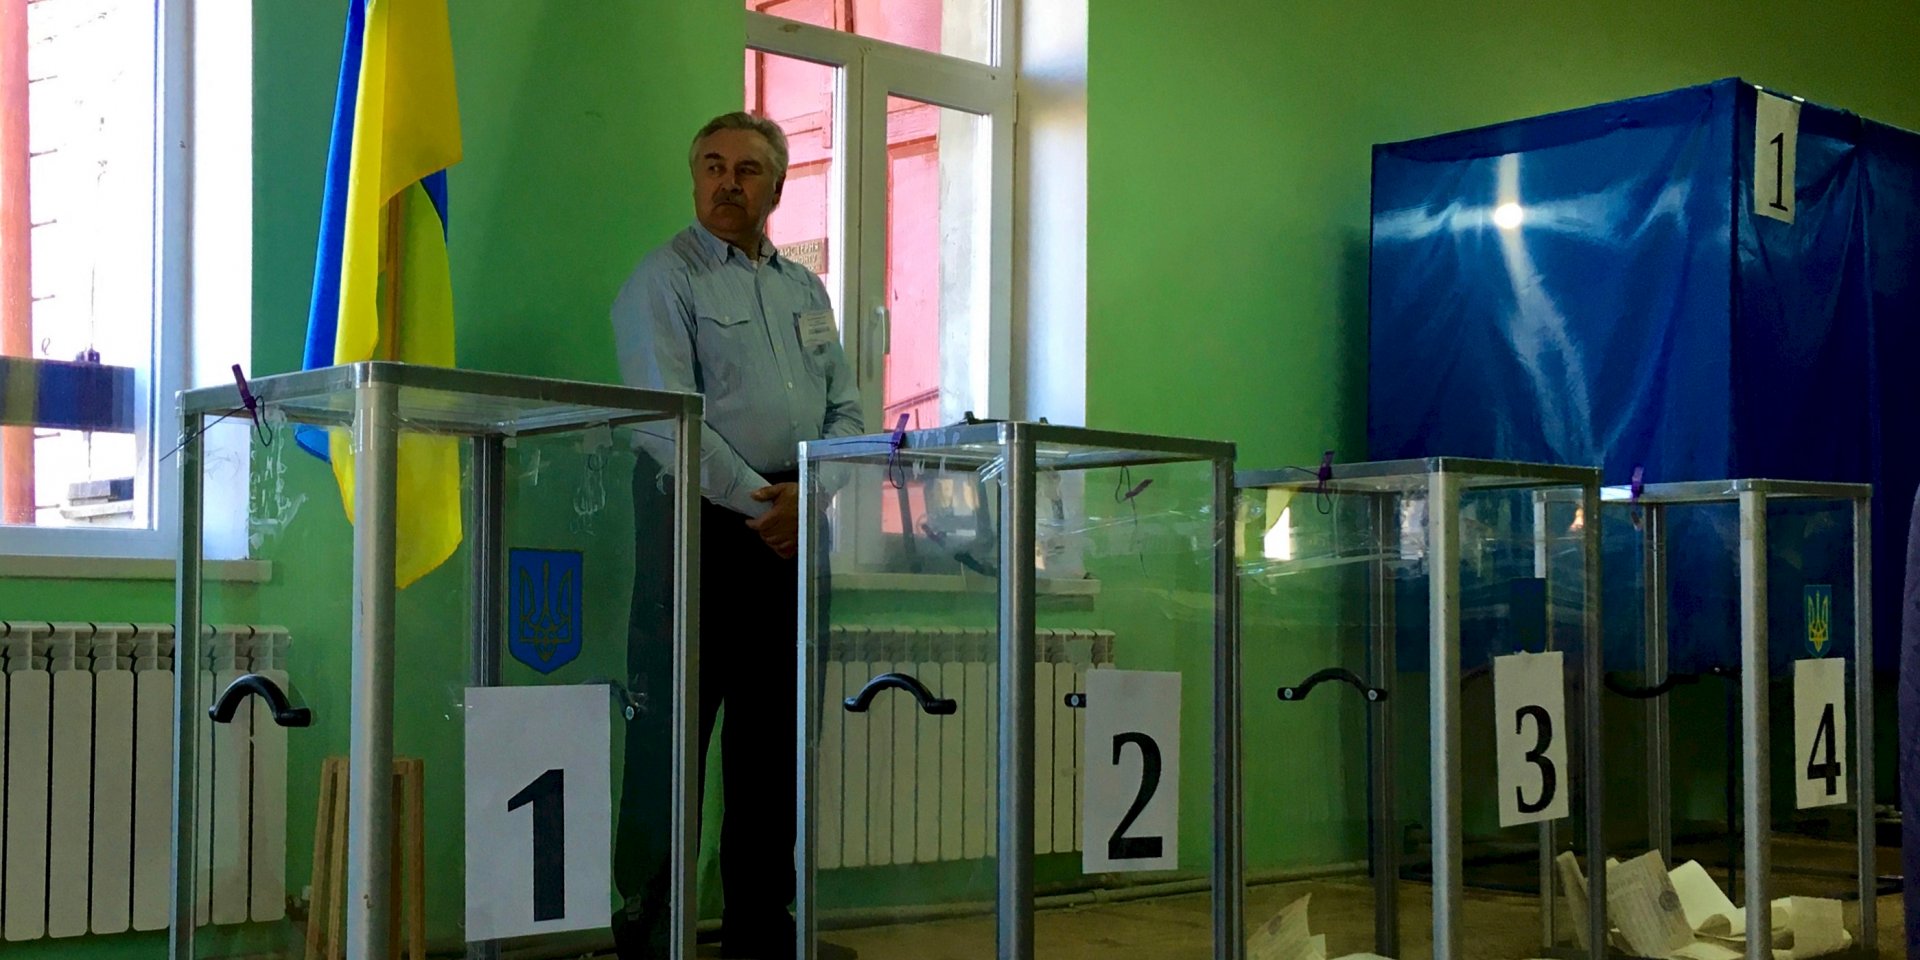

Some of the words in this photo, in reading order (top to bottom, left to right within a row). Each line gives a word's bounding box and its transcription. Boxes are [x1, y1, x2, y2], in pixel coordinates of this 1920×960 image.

[1769, 132, 1788, 212] 1
[1108, 732, 1163, 860] 2
[1516, 705, 1556, 813] 3
[1807, 703, 1841, 796] 4
[507, 768, 565, 922] 1
